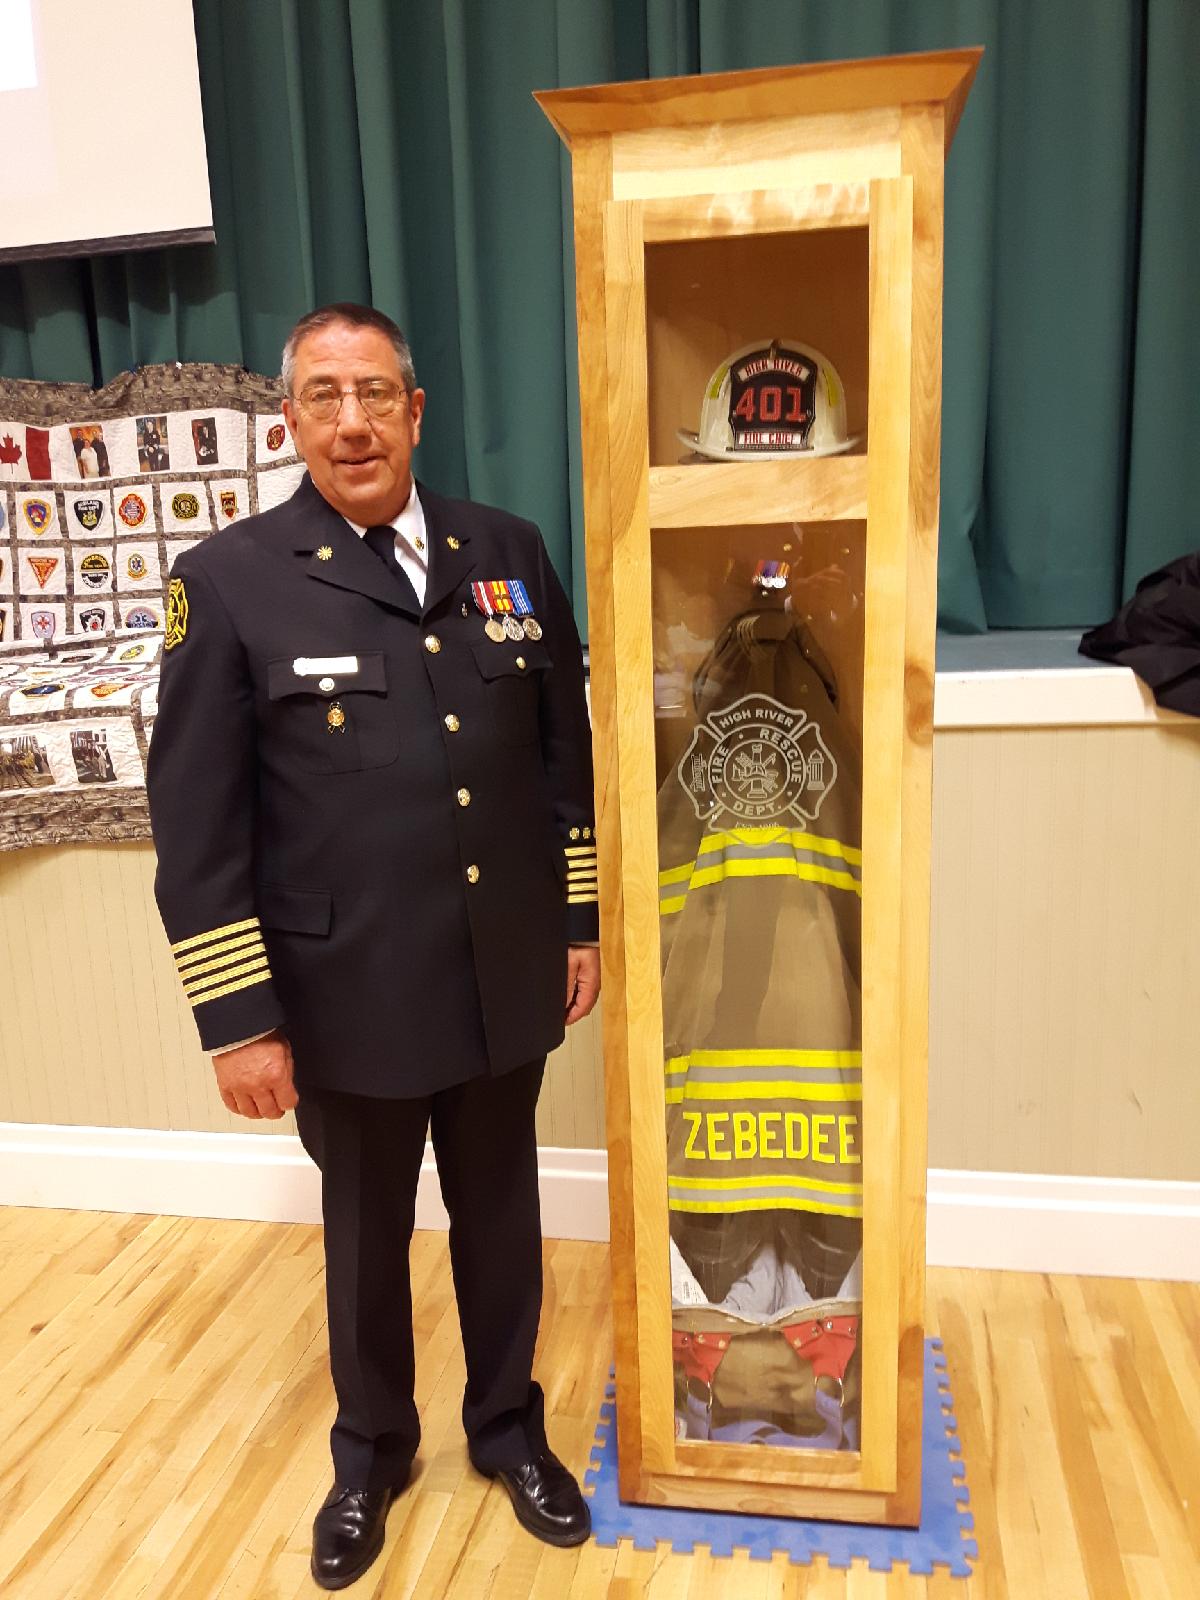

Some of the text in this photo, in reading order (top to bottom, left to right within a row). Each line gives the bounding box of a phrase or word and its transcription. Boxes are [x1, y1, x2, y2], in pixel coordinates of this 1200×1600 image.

[745, 359, 803, 377] HIGH RIVER
[735, 386, 806, 422] 401
[744, 431, 794, 445] FIRE CHIEF
[719, 709, 794, 729] HIGH RIVER
[711, 727, 801, 784] FIRE RESCUE
[682, 1111, 862, 1164] ZEBEDEE
